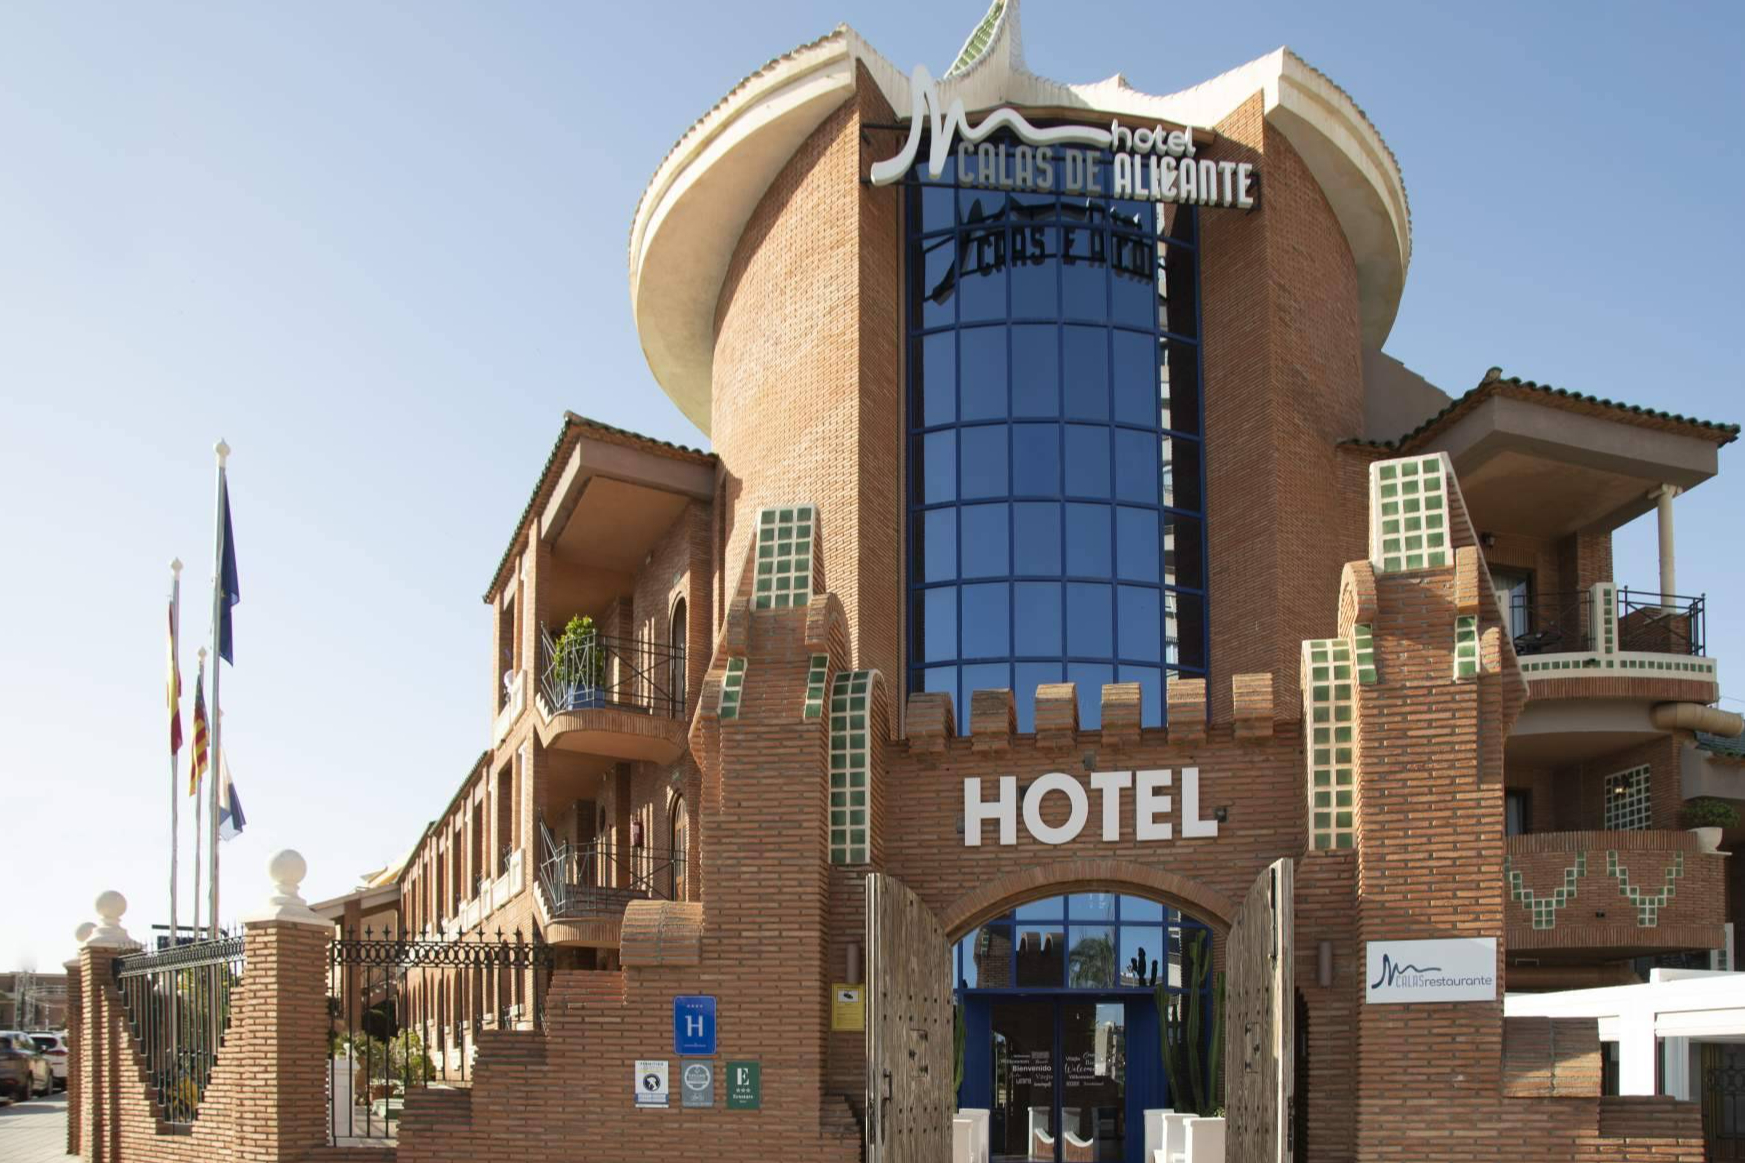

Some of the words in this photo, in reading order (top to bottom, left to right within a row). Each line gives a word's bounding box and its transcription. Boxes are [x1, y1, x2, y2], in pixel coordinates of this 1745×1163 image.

[1112, 118, 1197, 158] hotel
[957, 142, 1054, 192] CALAS
[1065, 148, 1101, 196] DE
[1113, 153, 1254, 209] ALICANTE
[964, 767, 1219, 847] HOTEL
[685, 1015, 704, 1038] H
[1012, 1064, 1052, 1072] Bienvenido
